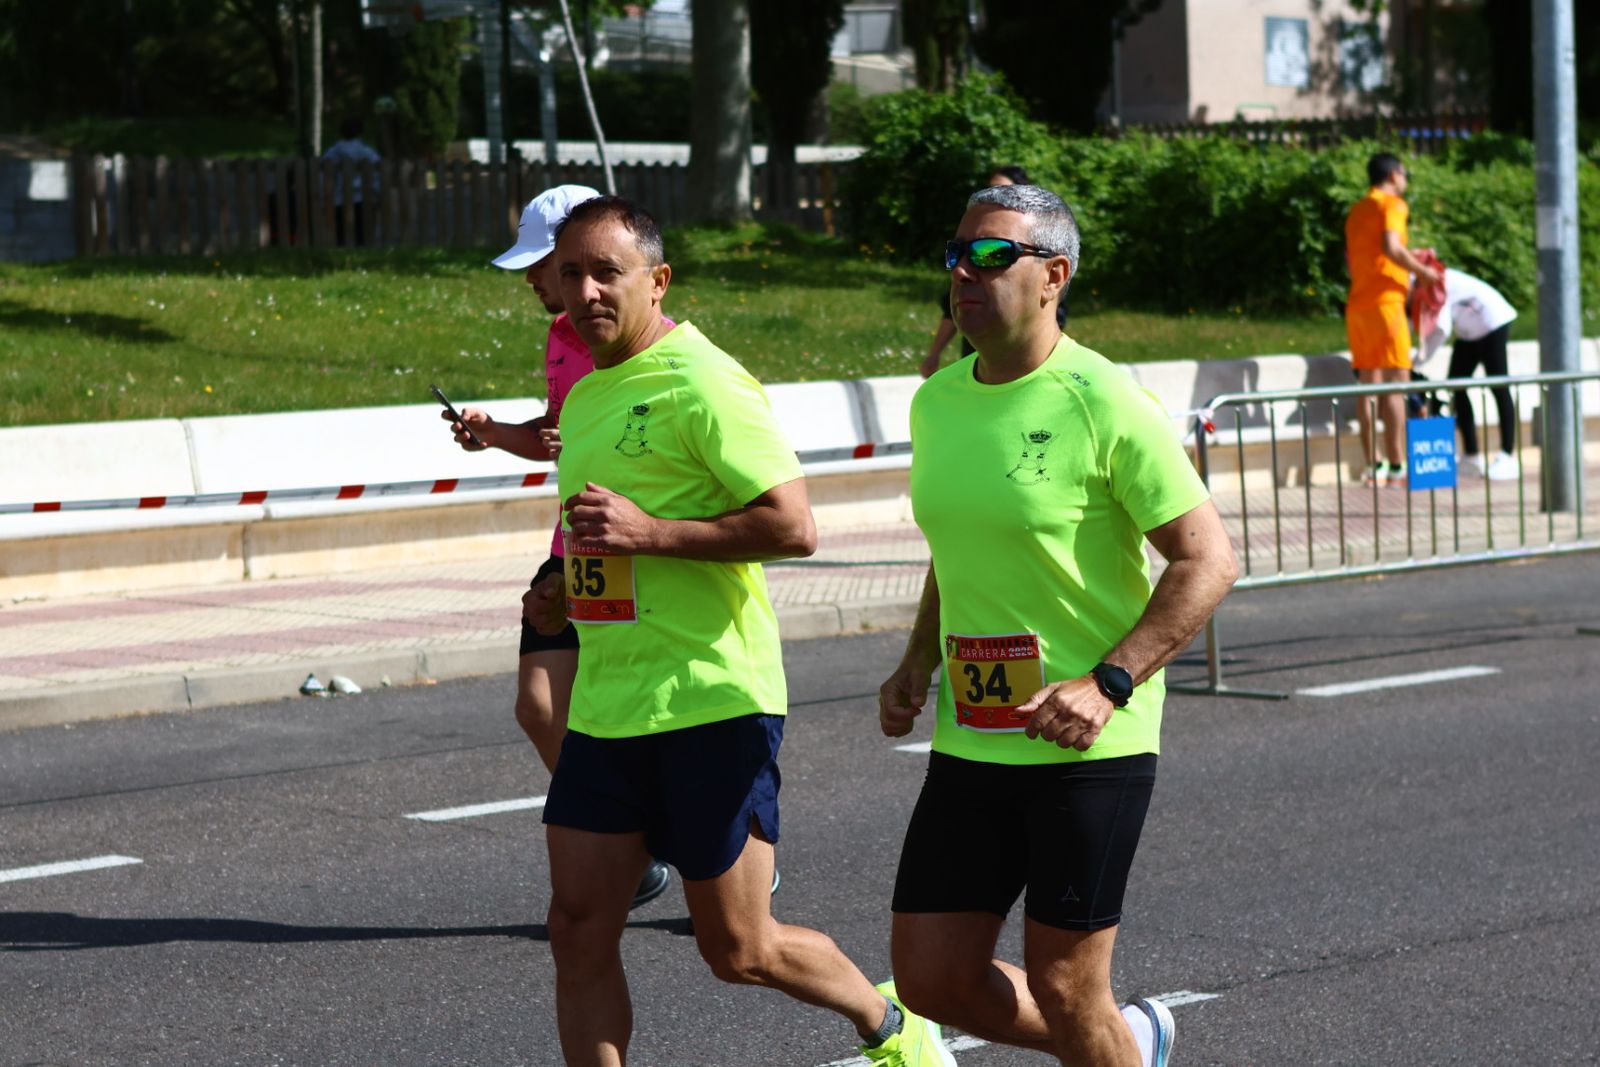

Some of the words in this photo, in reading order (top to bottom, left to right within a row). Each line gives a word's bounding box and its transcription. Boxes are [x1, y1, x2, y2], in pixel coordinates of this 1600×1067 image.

[571, 557, 606, 597] 35
[961, 648, 1007, 659] CARRERA
[963, 663, 1013, 703] 34
